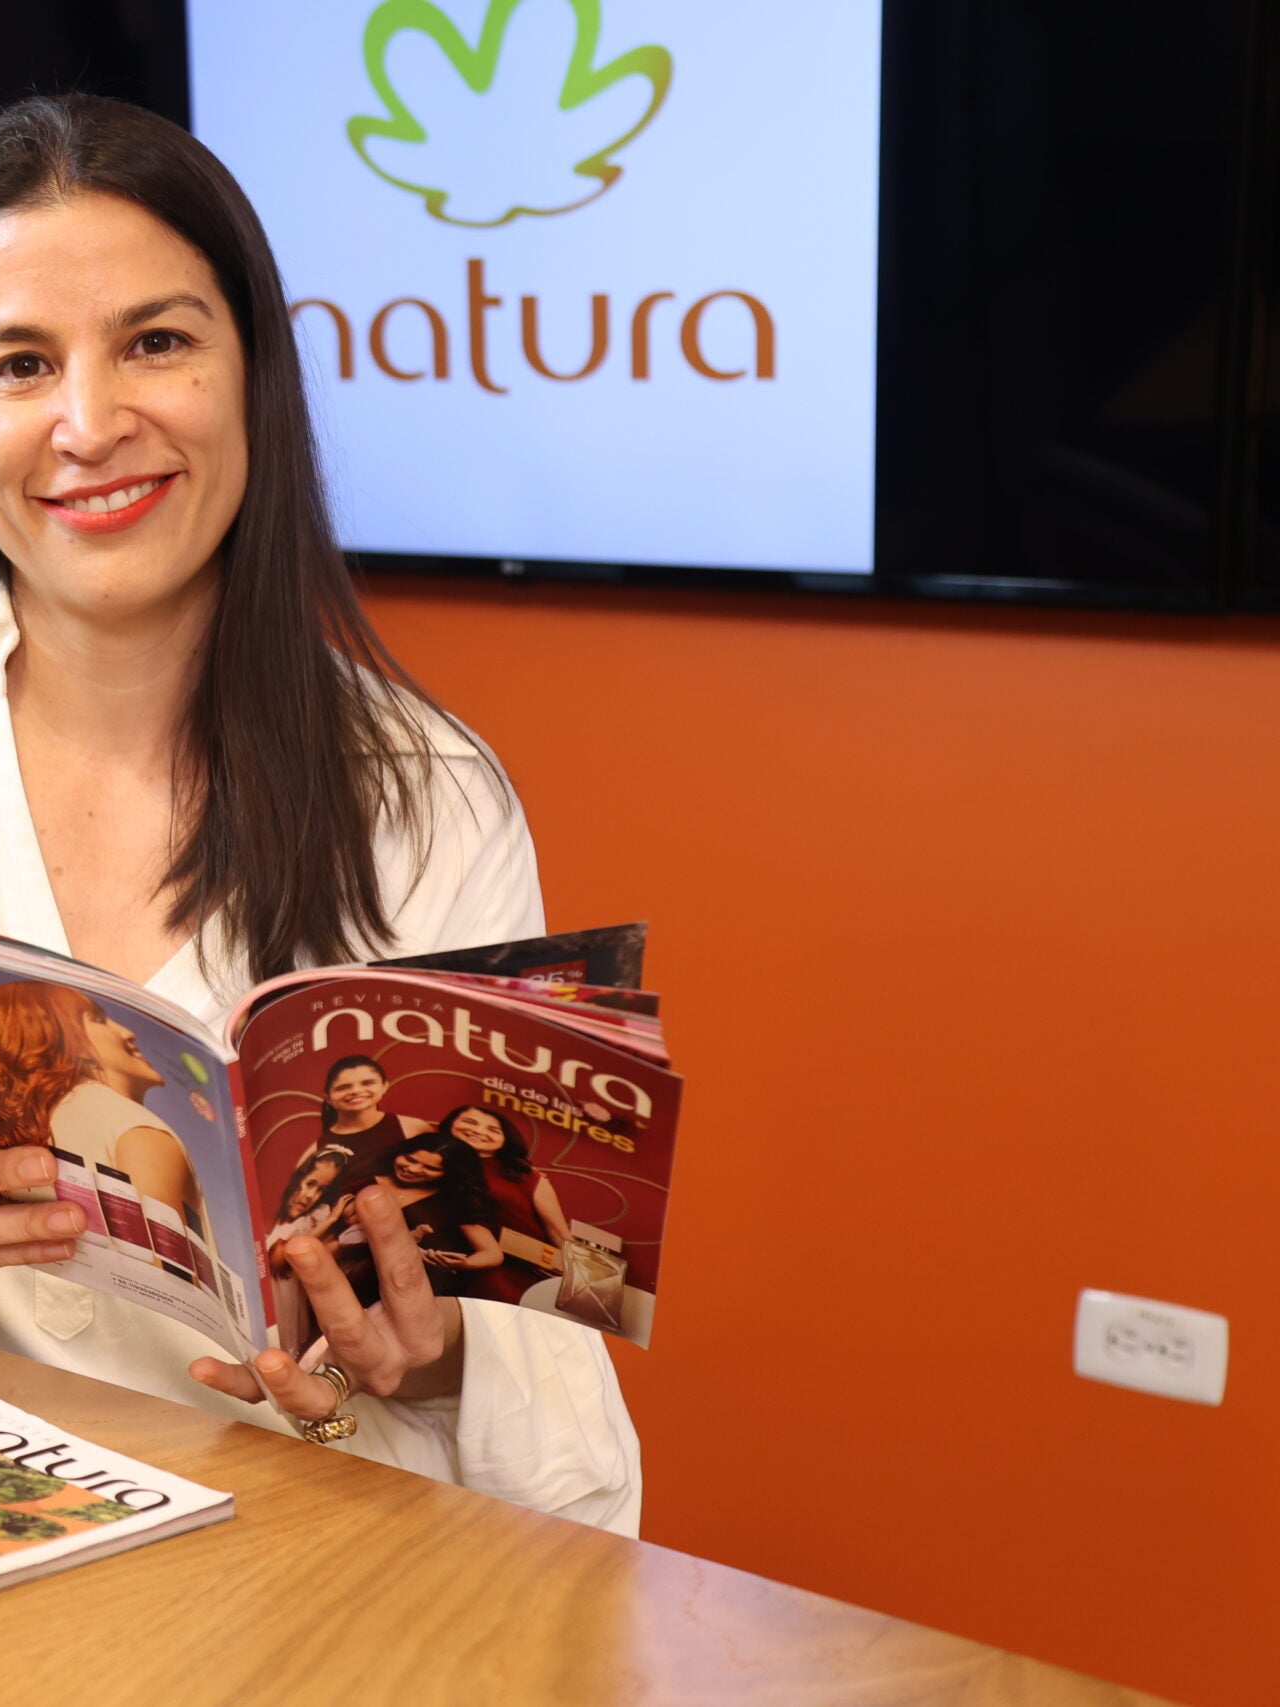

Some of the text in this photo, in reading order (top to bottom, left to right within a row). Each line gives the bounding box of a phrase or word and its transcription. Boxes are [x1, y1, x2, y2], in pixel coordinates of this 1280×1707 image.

[289, 258, 777, 395] natura
[312, 993, 444, 1013] REVISTA
[312, 1007, 652, 1119] natura
[483, 1076, 516, 1094] día
[521, 1087, 549, 1105] de
[483, 1087, 636, 1153] madres
